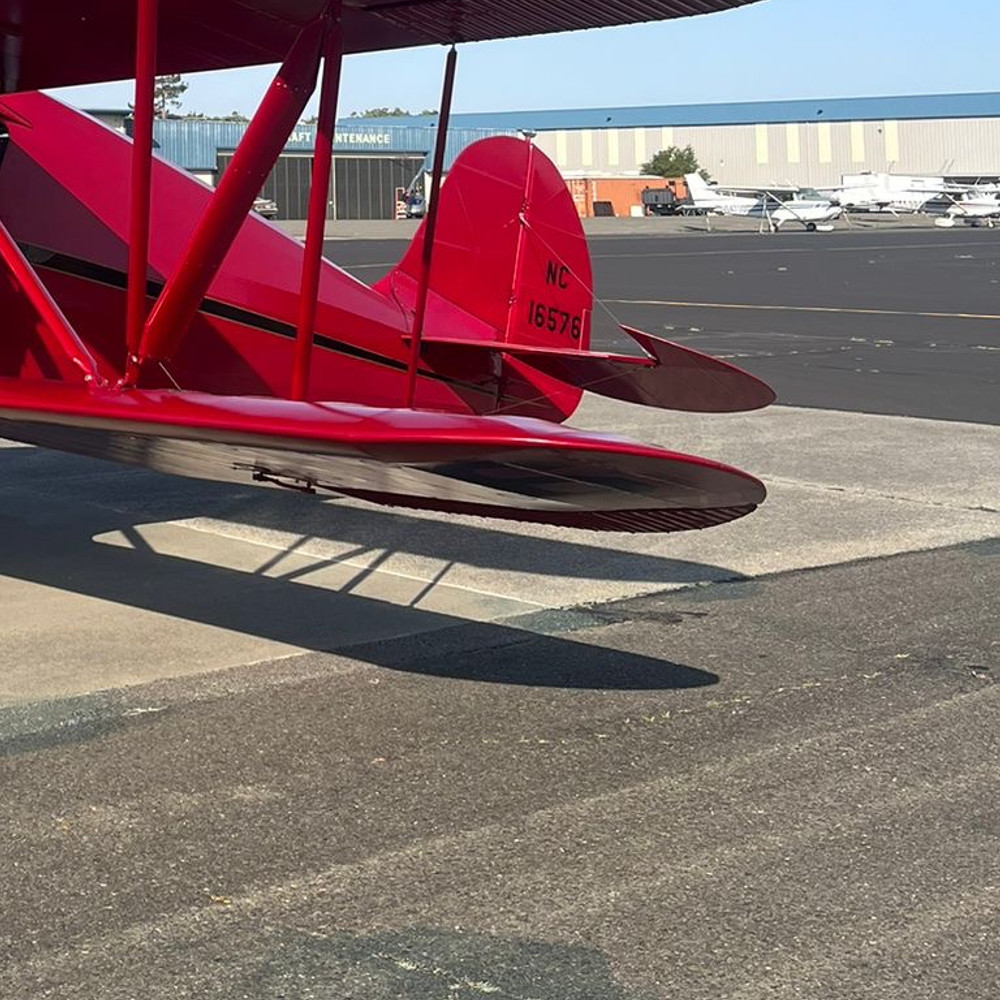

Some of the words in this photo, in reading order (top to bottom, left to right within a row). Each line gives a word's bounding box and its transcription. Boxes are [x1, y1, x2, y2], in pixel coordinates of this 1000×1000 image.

[289, 132, 311, 142] AFT
[334, 132, 390, 144] NTENANCE
[546, 260, 570, 289] NC
[528, 300, 582, 340] 16576
